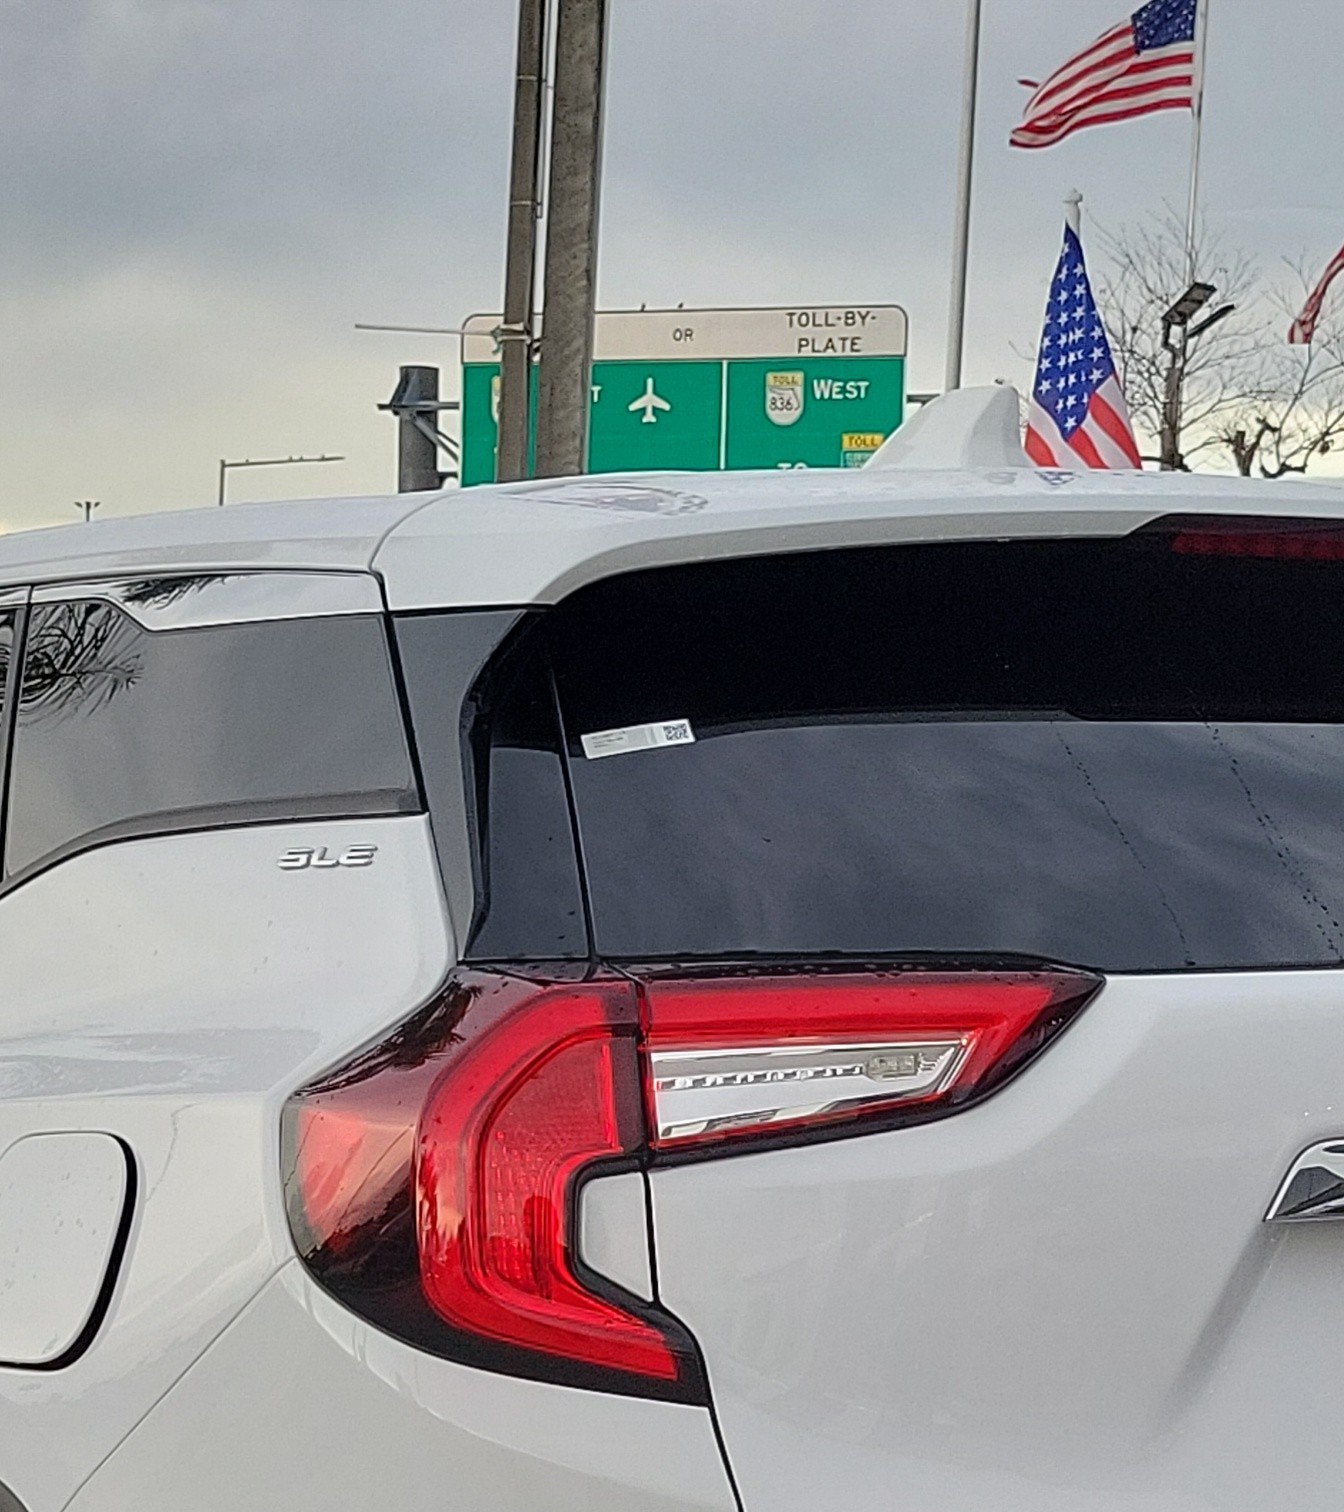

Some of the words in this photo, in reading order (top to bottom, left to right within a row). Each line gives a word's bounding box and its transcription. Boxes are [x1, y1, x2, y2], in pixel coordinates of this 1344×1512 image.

[672, 328, 695, 342] OR
[797, 336, 862, 354] PLATE
[772, 375, 799, 386] TOLL
[812, 378, 870, 400] WEST
[768, 396, 794, 412] 836
[847, 435, 879, 448] TOLL
[277, 844, 379, 870] SLE
